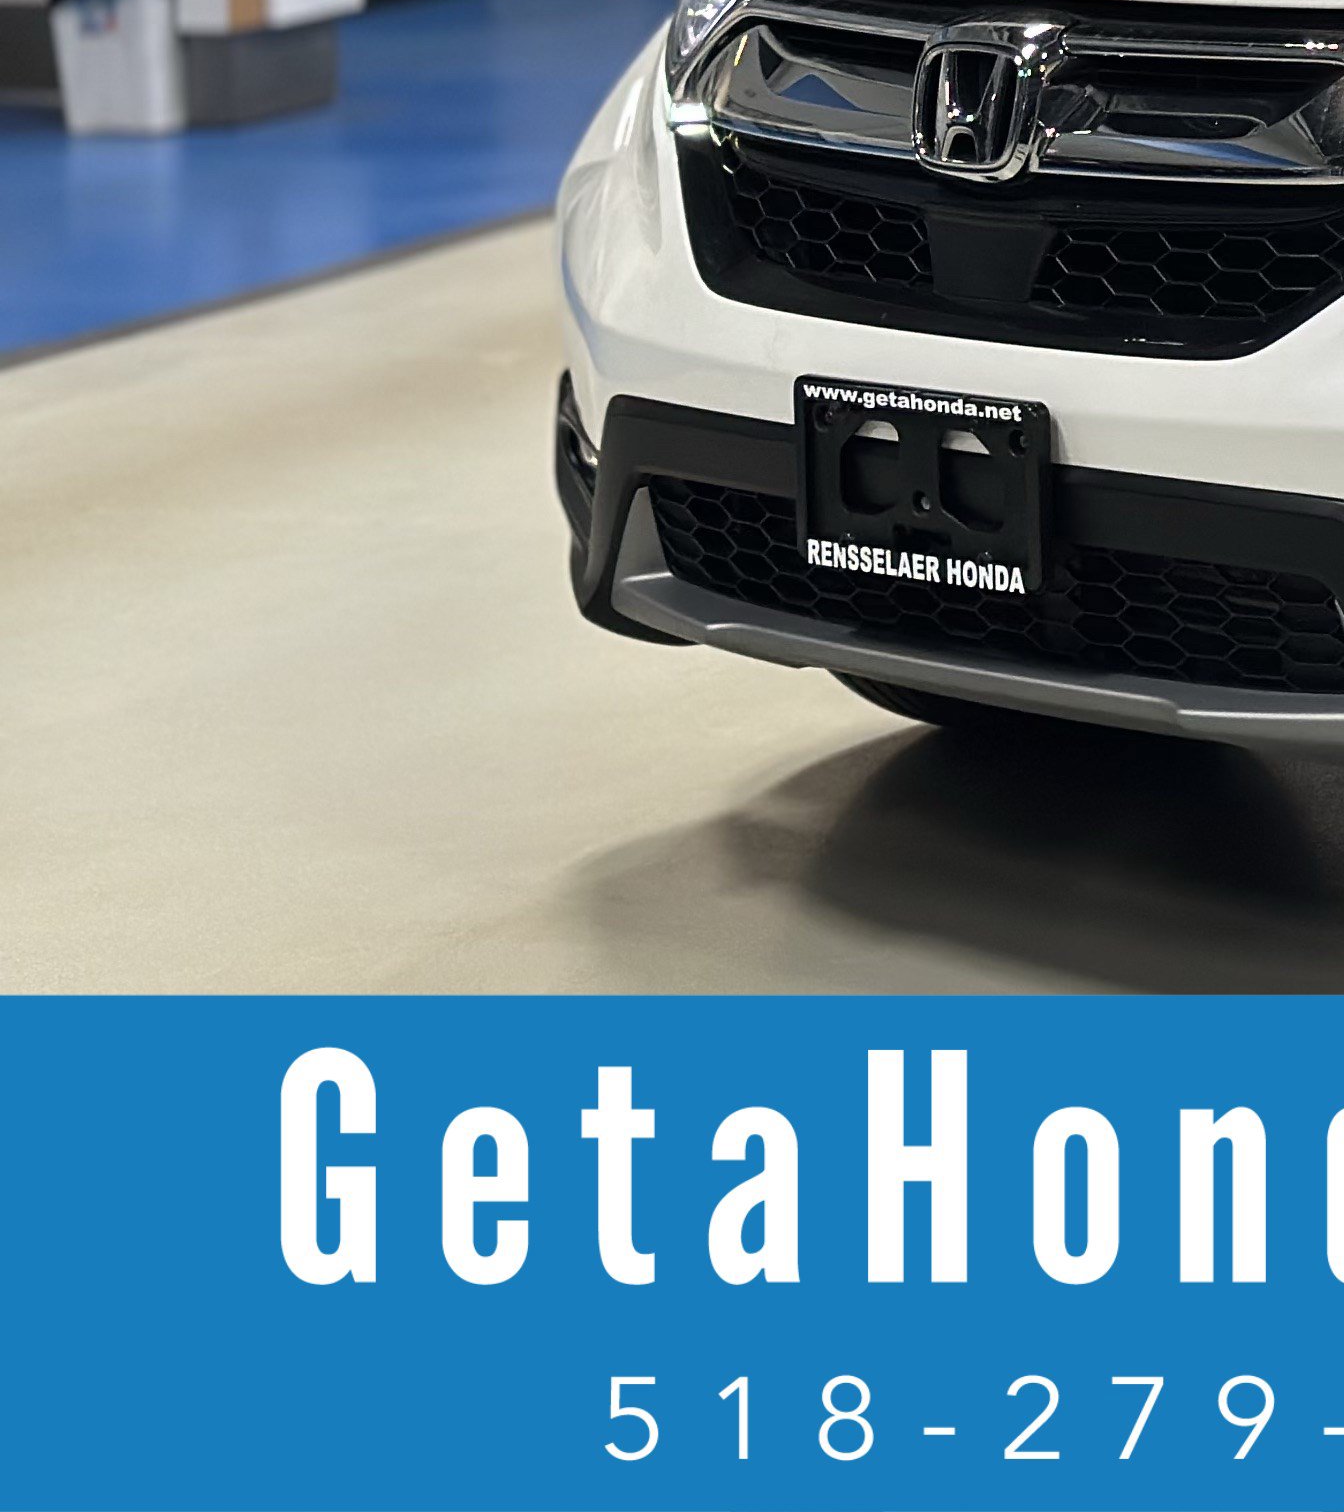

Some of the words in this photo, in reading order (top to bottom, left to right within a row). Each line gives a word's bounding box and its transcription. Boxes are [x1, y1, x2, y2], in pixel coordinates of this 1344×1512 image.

[803, 384, 1022, 422] www.getahonda.net
[807, 539, 940, 583] RENSSELAER
[946, 558, 1026, 595] HONDA
